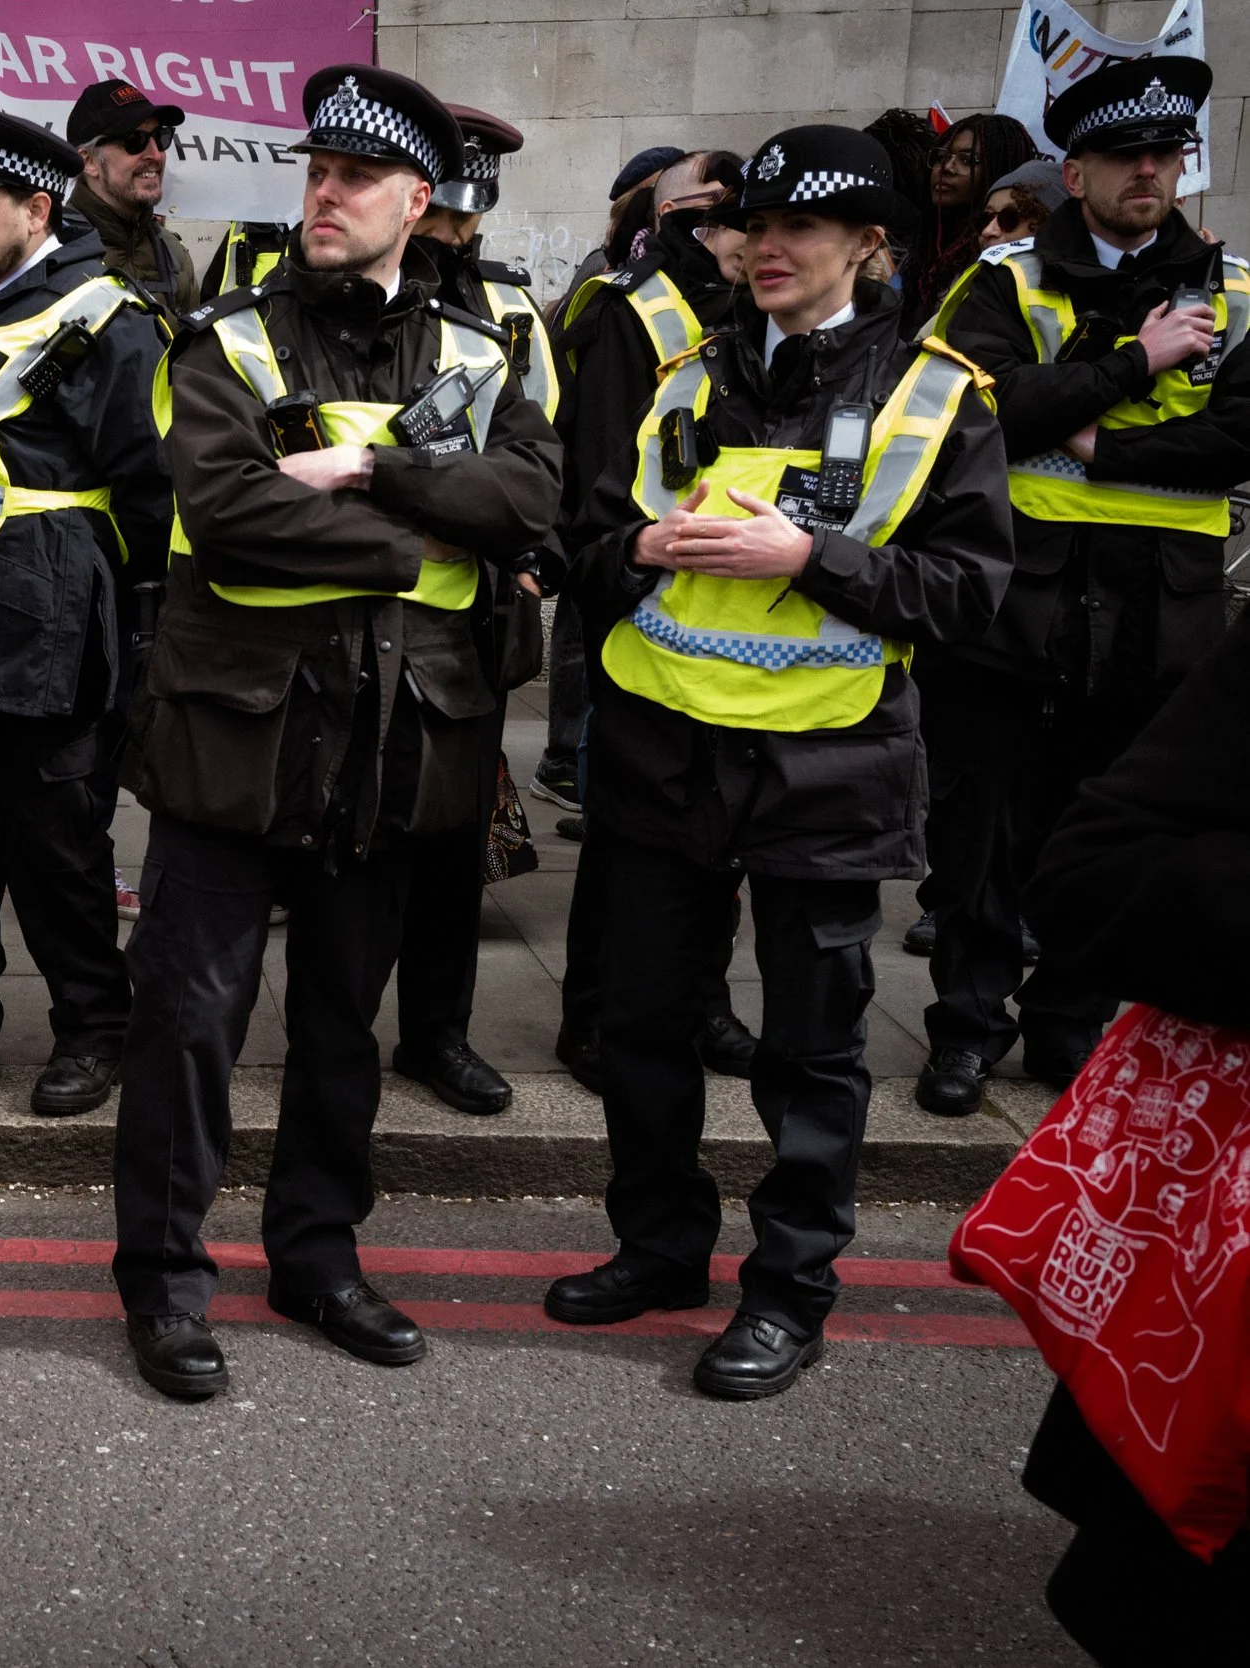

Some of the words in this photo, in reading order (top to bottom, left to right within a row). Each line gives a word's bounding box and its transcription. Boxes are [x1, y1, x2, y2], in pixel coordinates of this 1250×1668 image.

[83, 42, 295, 113] RIGHT
[172, 133, 298, 165] HATE
[1192, 371, 1213, 381] POLICE
[428, 437, 466, 450] METROPOLITAN
[435, 444, 463, 456] POLICE
[787, 516, 806, 526] LICE
[807, 519, 844, 532] OFFICER
[1059, 1207, 1136, 1279] RED
[1049, 1237, 1127, 1304] RUN
[1040, 1260, 1115, 1326] LDN
